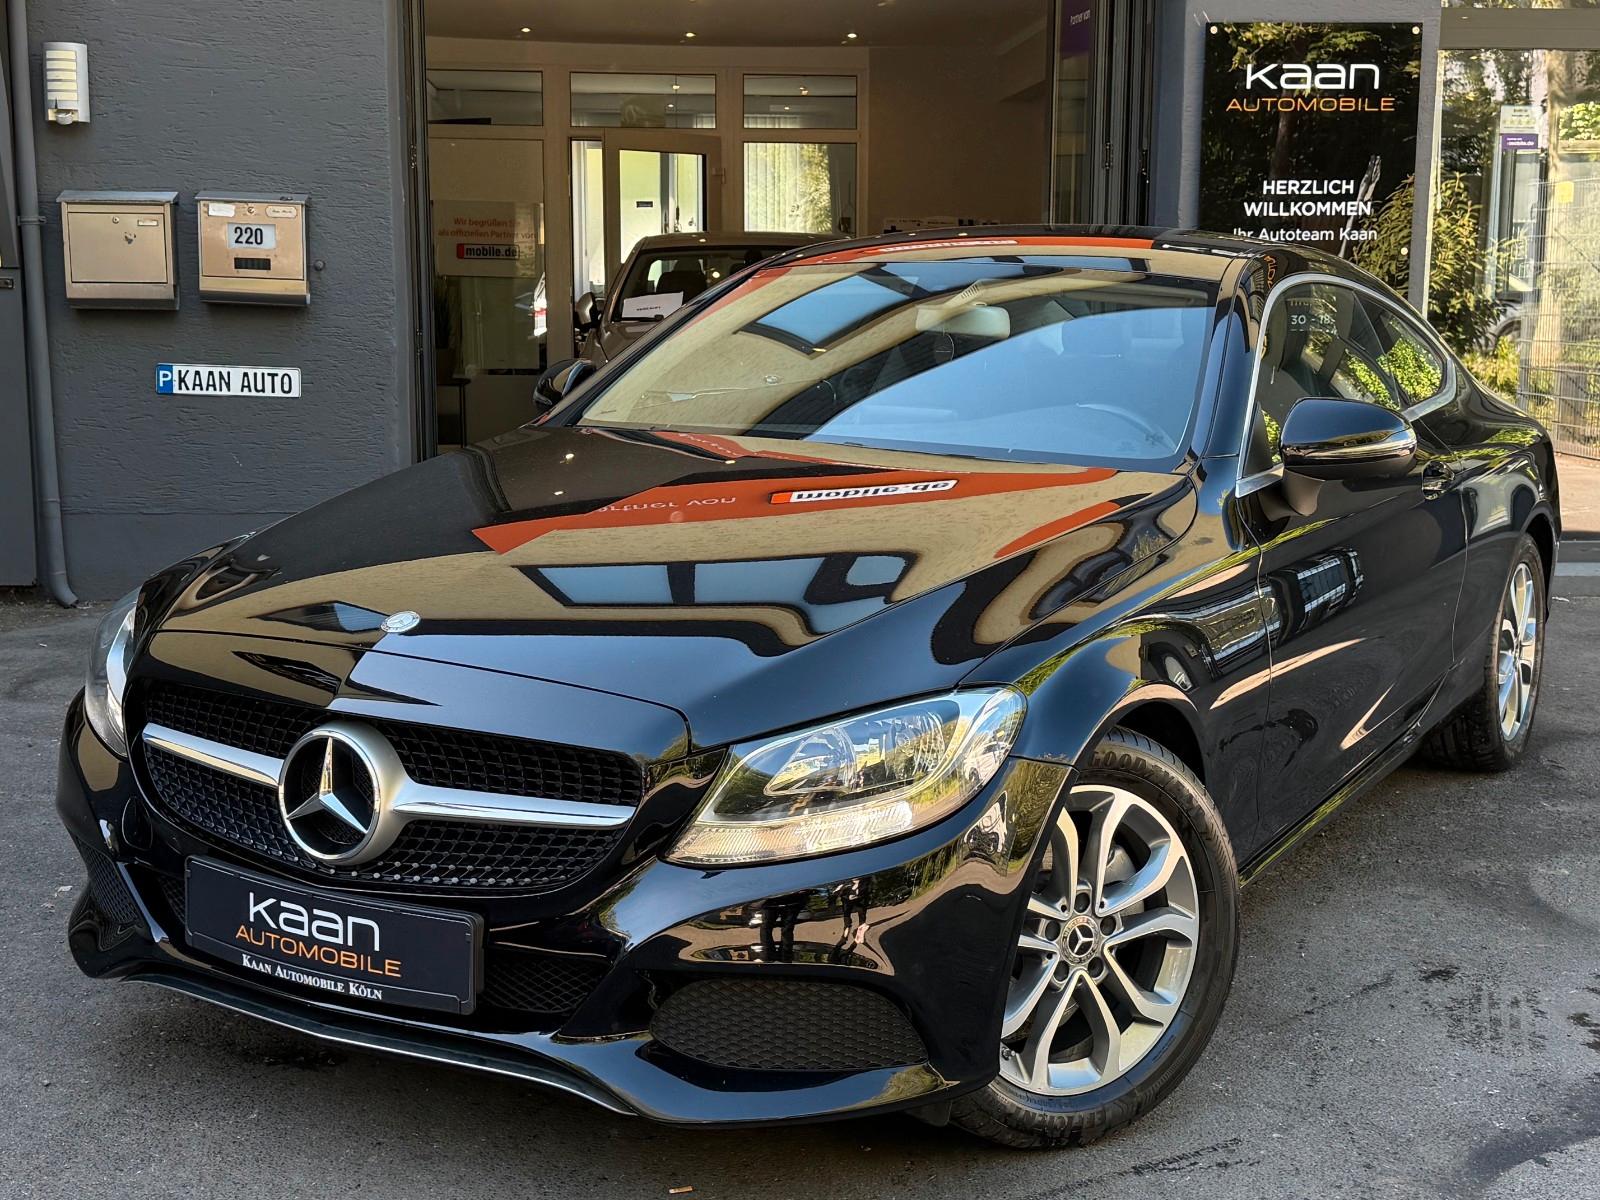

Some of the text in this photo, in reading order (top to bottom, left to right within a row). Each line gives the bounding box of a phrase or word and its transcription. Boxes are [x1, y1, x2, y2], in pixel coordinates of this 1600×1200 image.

[1245, 63, 1380, 90] kaan
[1225, 97, 1396, 112] AUTOMOBILE
[1262, 179, 1354, 195] HERZLICH
[1243, 201, 1372, 217] WILLKOMMEN
[234, 226, 264, 245] 220
[1258, 228, 1335, 242] Autoteam
[1339, 228, 1378, 241] Kaan
[465, 245, 518, 257] mobile.de
[178, 370, 231, 392] KAAN
[240, 372, 293, 394] AUTO
[249, 892, 380, 952] kaan
[235, 925, 402, 978] AUTOMOBILE
